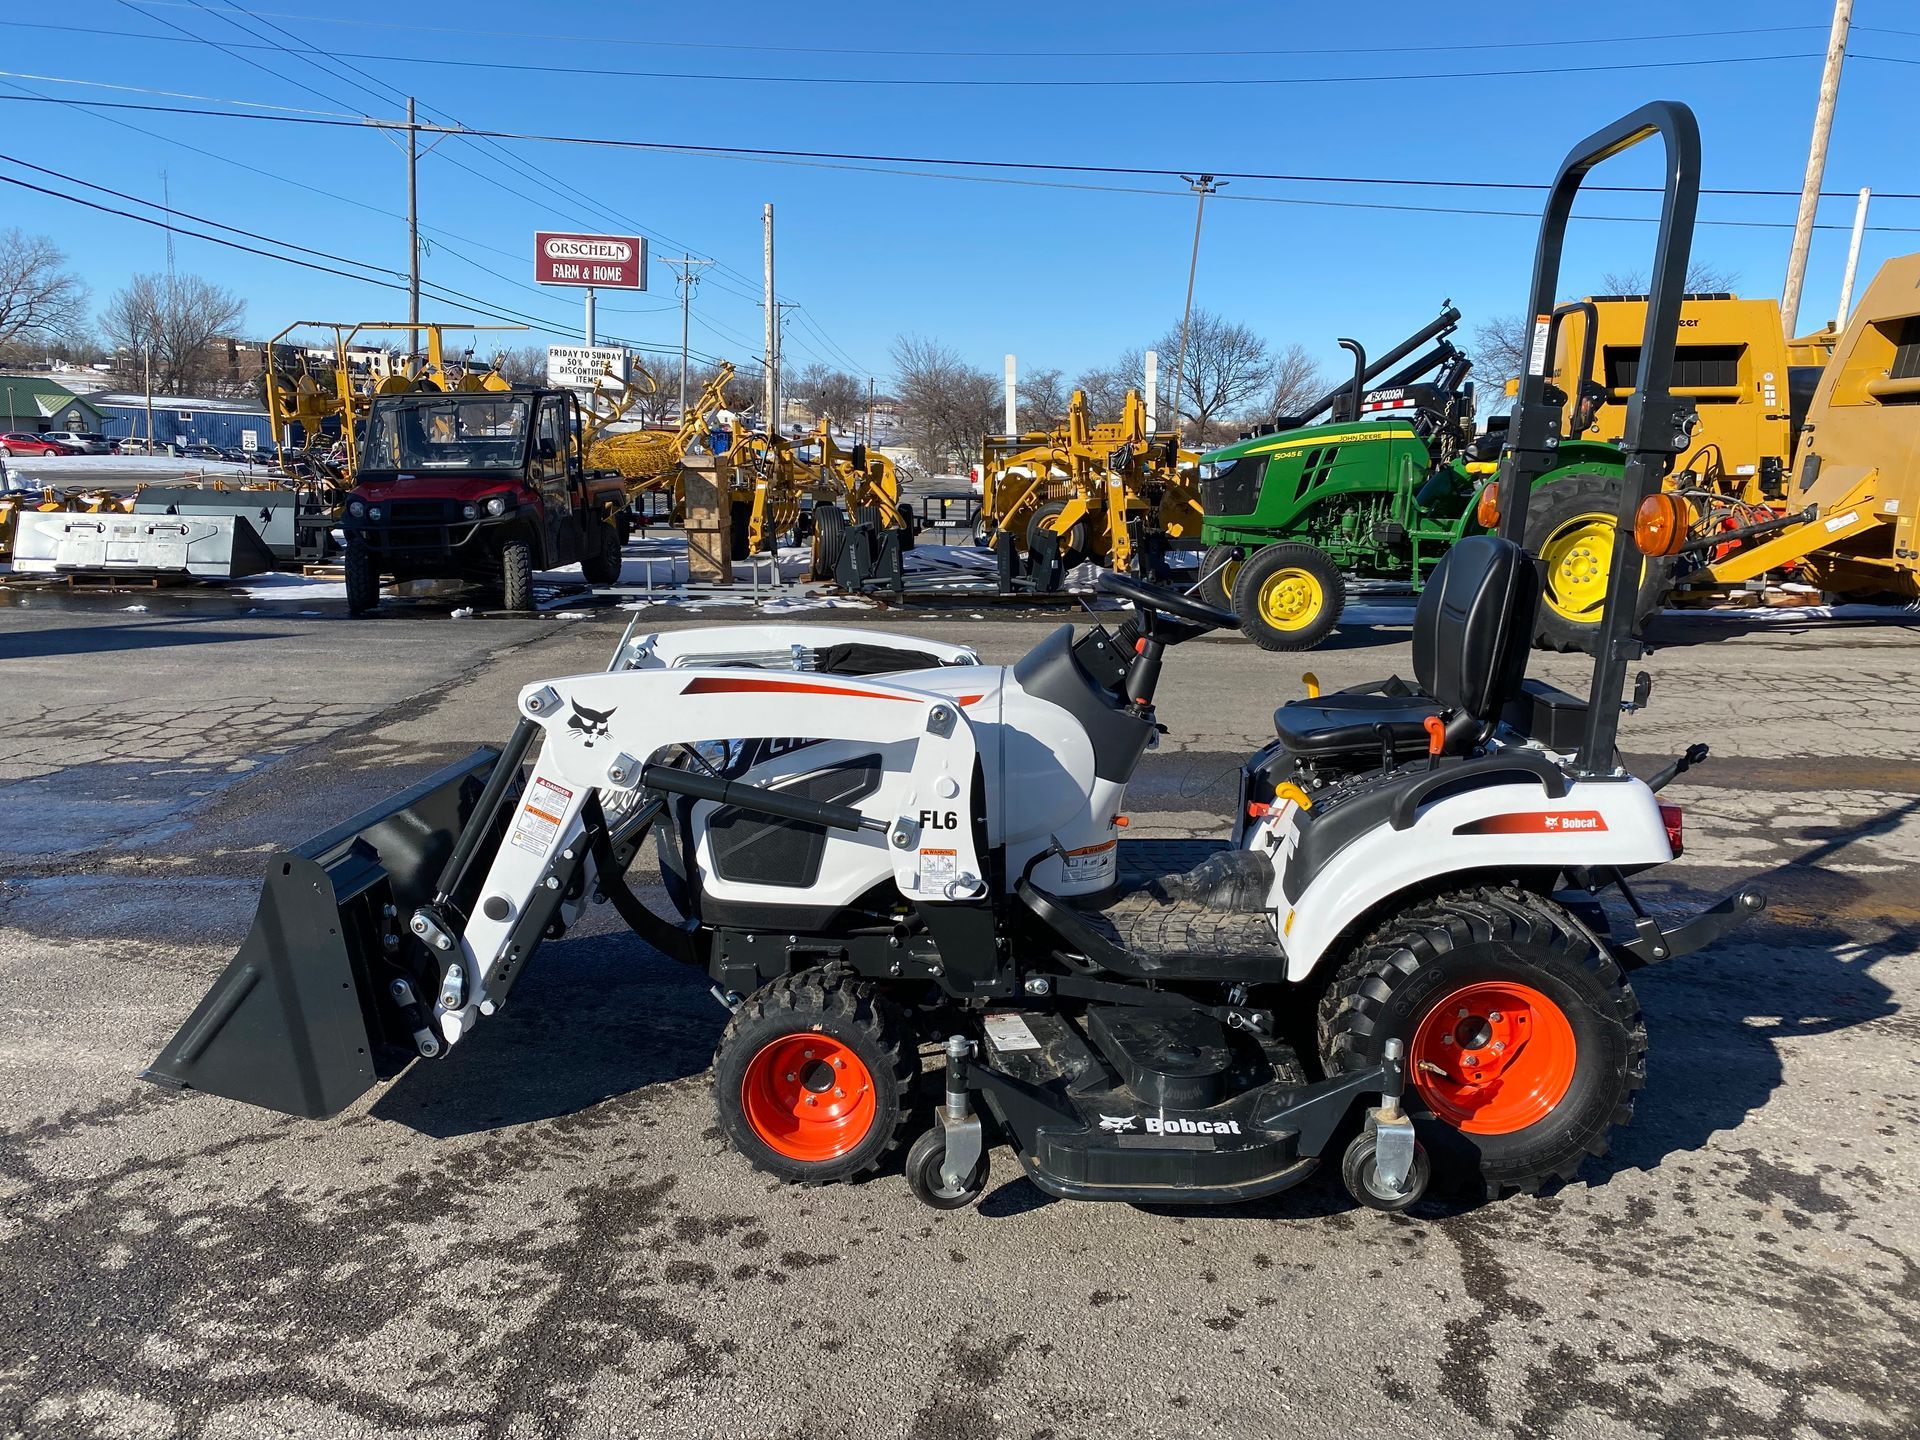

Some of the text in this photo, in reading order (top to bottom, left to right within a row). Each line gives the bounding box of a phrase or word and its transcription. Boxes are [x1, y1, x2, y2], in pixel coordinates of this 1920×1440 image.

[550, 242, 625, 260] ORSCHELN
[552, 263, 622, 281] FARM & HOME
[1679, 319, 1698, 327] eer
[549, 348, 622, 361] FRIDAY TO SUNDAY
[567, 358, 583, 367] 50%
[560, 366, 612, 376] DISCONTINUD
[576, 375, 598, 384] ITEMS
[1358, 433, 1382, 441] DEERE
[244, 440, 256, 448] 25
[1274, 451, 1297, 461] 5045
[545, 781, 570, 796] DANGER
[533, 809, 558, 823] WARNING
[920, 810, 957, 830] FL6
[1562, 817, 1596, 829] Bobcat
[1145, 1117, 1242, 1135] Bobcat
